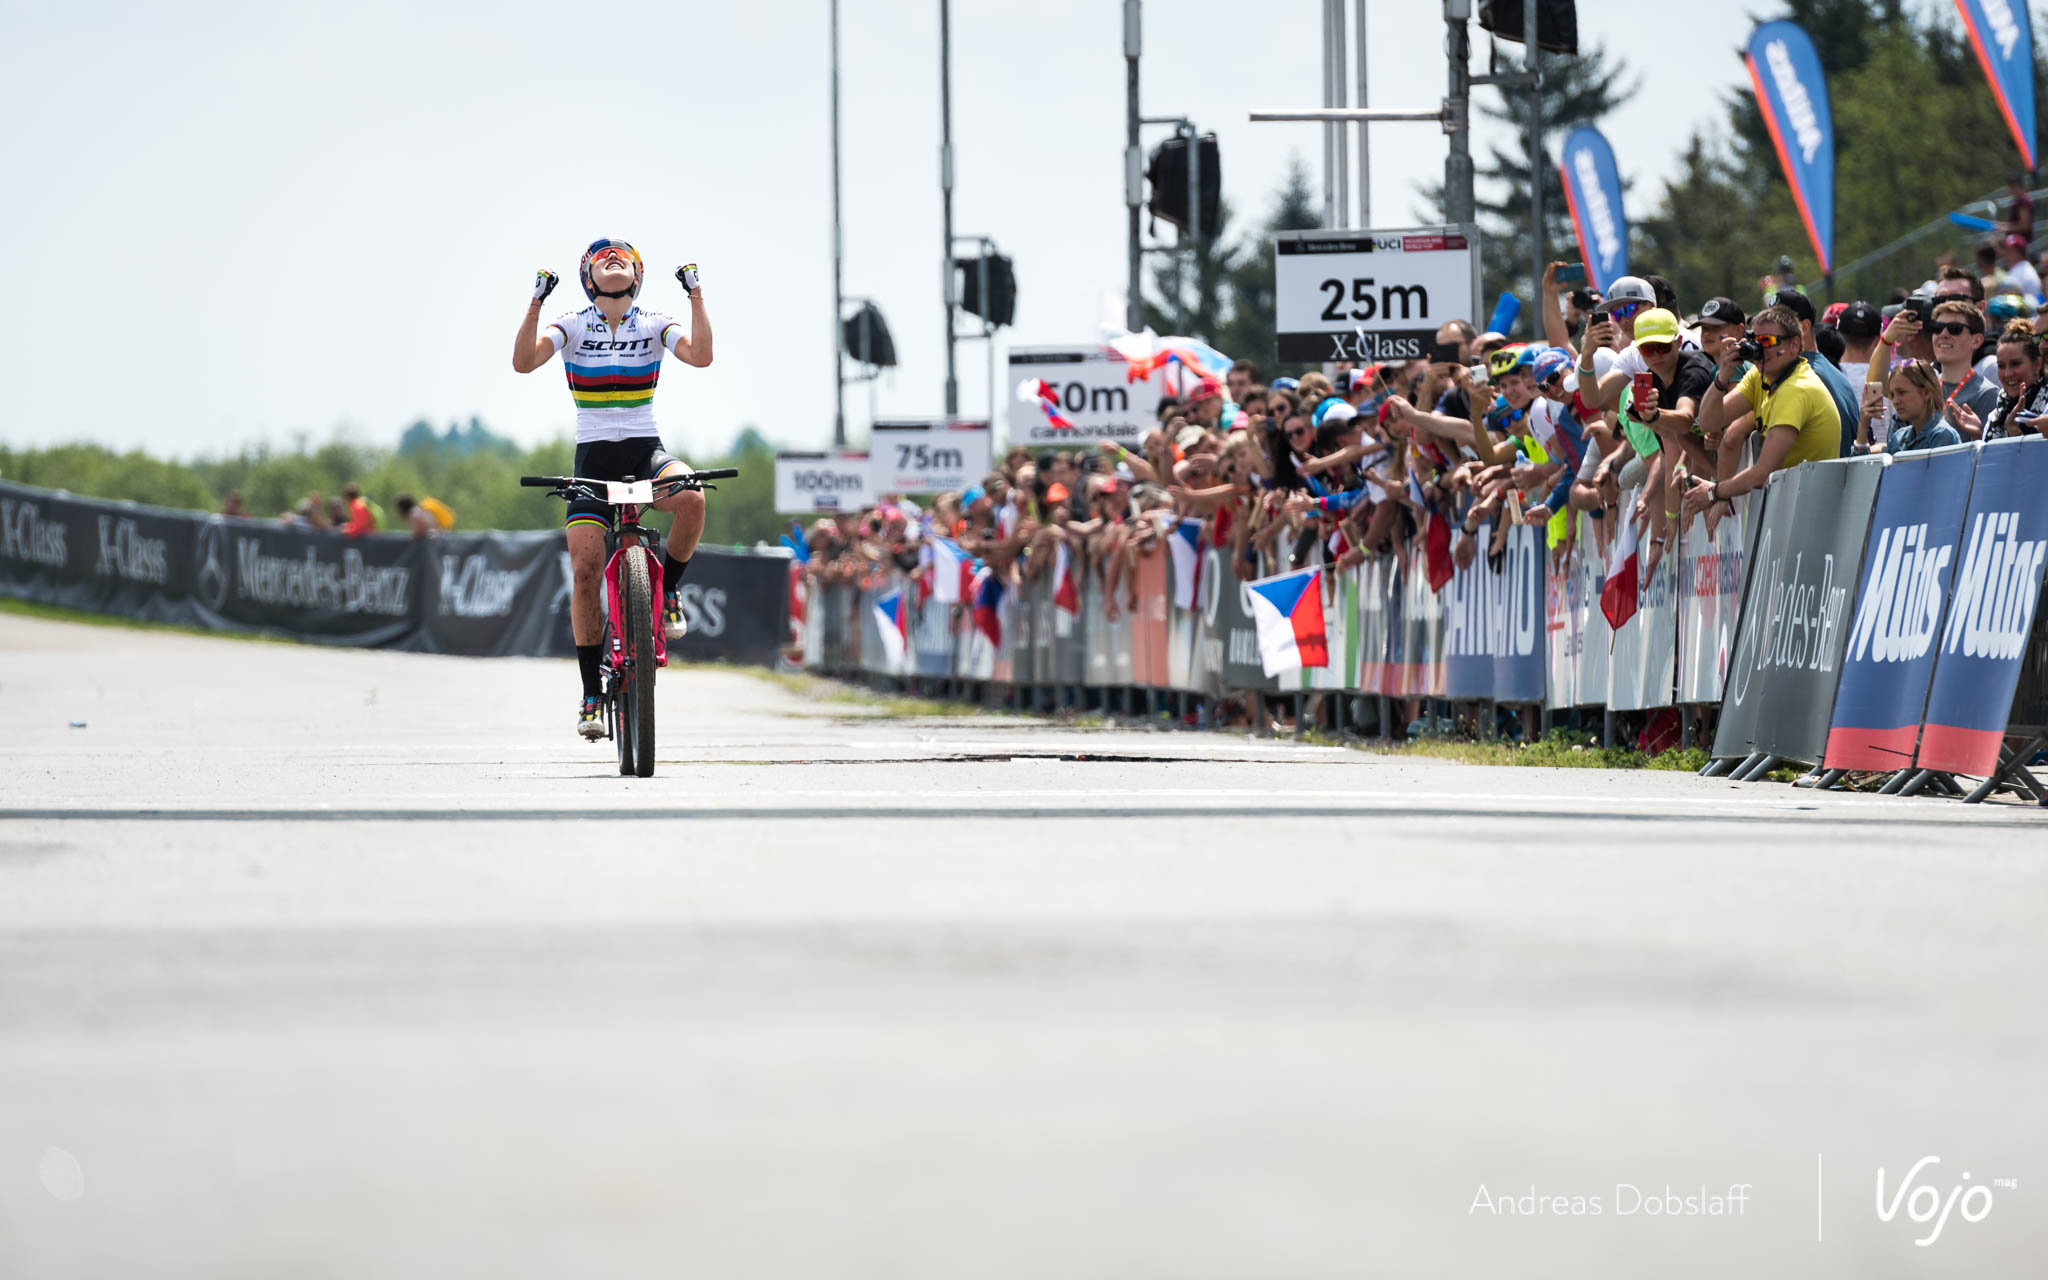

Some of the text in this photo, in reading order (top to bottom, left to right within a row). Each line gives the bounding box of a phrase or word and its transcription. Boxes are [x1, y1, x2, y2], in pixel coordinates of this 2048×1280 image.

[1376, 239, 1401, 250] UCI
[1319, 277, 1429, 321] 25m
[580, 337, 653, 351] SCOTT
[1330, 333, 1421, 360] X-Class
[895, 443, 963, 469] 75m
[794, 469, 862, 491] 100m
[237, 536, 409, 616] Mercedes-Benz
[1940, 512, 2047, 661] Mitas
[1845, 523, 1952, 663] Mitas
